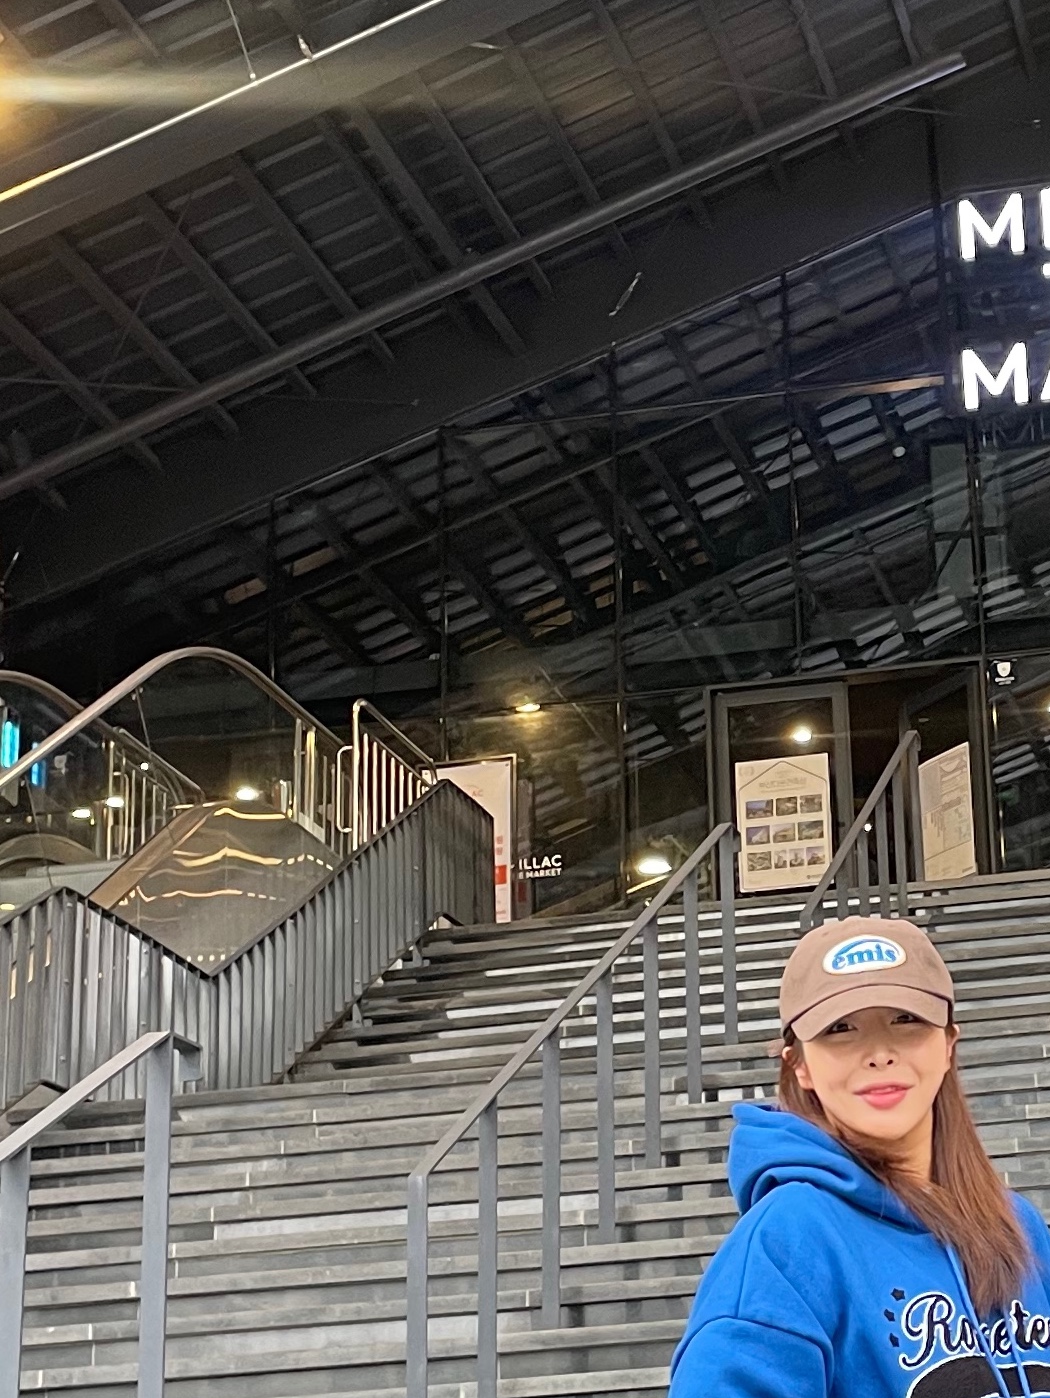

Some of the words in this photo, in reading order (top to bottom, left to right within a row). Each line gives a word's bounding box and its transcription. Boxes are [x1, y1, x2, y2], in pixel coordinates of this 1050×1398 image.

[511, 854, 562, 870] ILLAC
[525, 867, 562, 879] MARKET
[831, 943, 897, 970] emis
